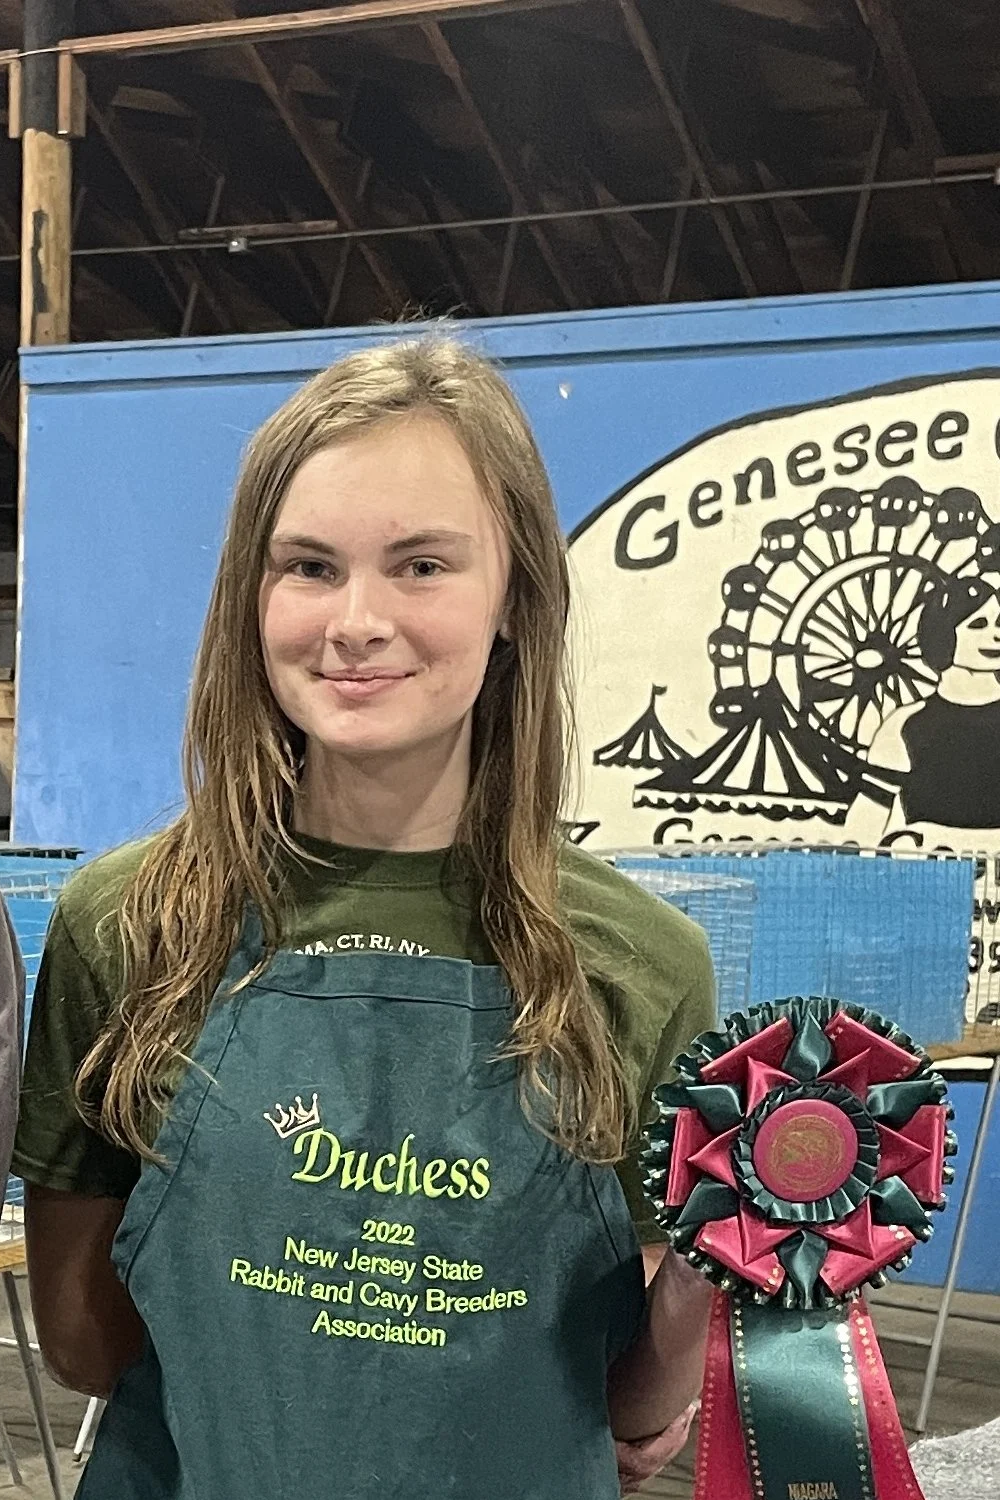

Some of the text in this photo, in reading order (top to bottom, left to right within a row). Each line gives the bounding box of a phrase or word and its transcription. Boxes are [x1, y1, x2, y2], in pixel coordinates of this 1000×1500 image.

[614, 411, 969, 570] Genesee
[369, 934, 394, 953] RI,
[291, 1128, 492, 1200] Duchess
[361, 1219, 416, 1247] 2022
[284, 1236, 484, 1285] New Jersey State
[230, 1258, 528, 1317] Rabbit and Cavy Breeders
[311, 1310, 447, 1347] Association
[787, 1481, 839, 1500] NIAGARA
